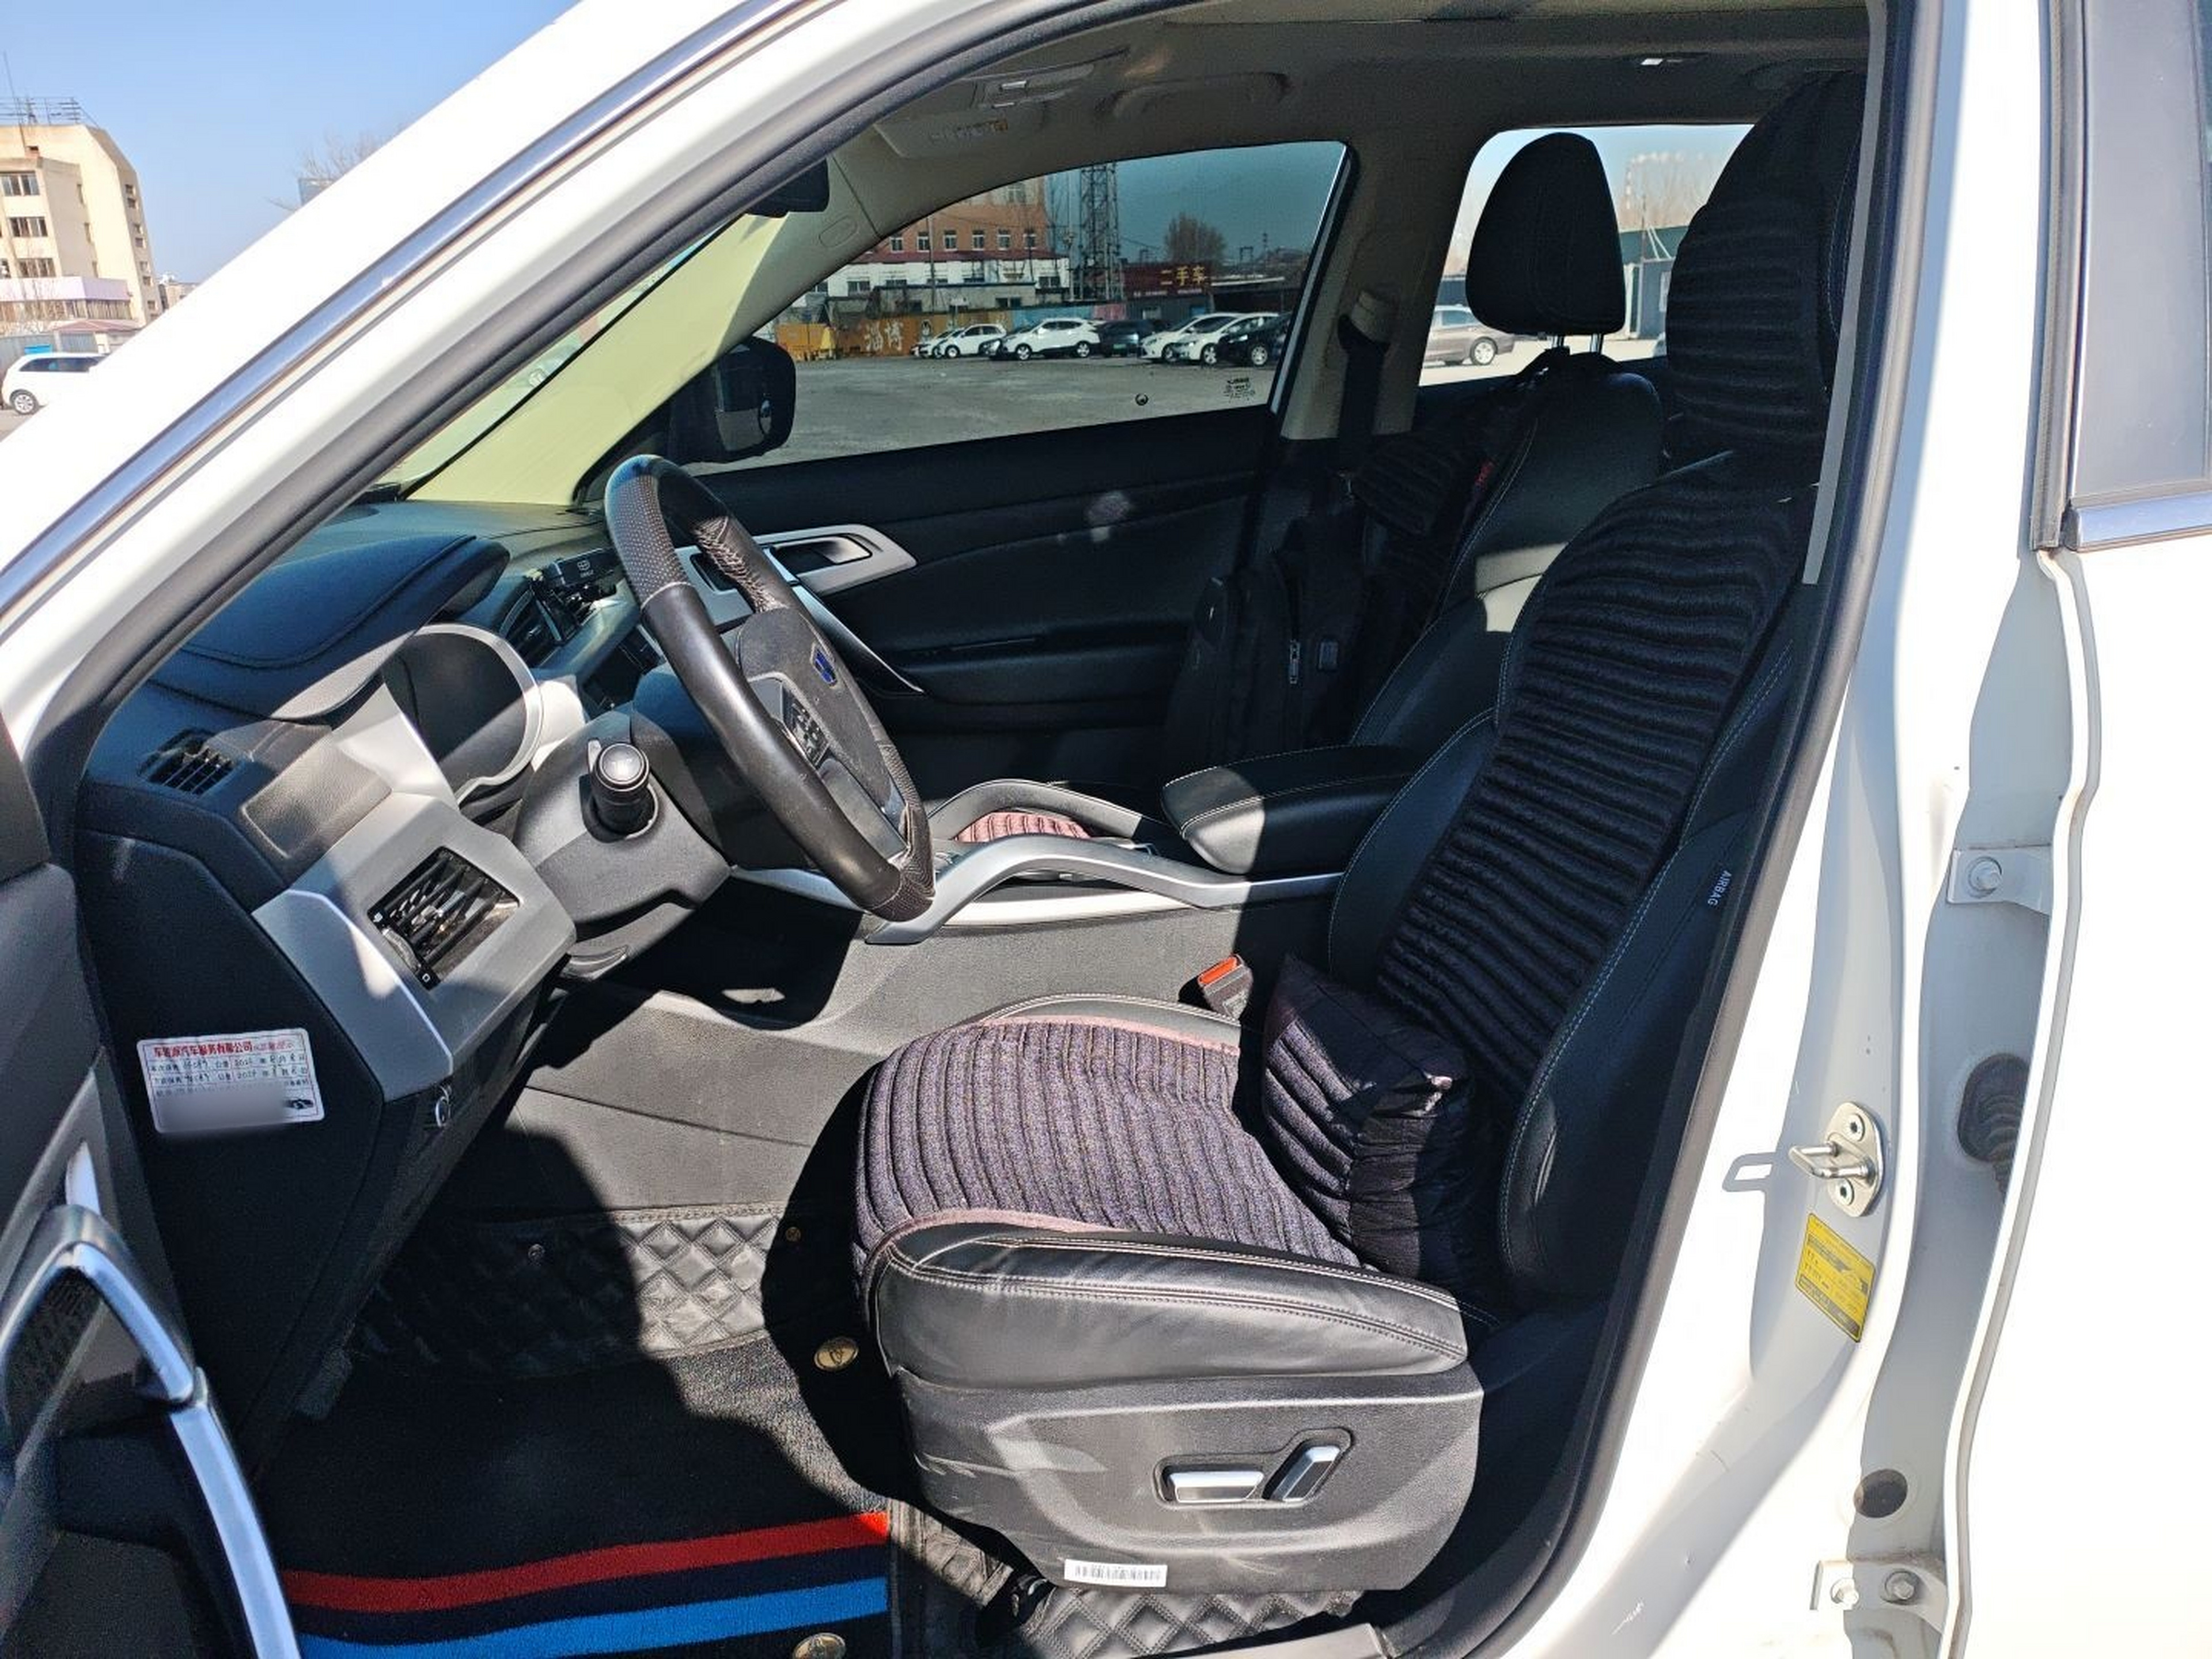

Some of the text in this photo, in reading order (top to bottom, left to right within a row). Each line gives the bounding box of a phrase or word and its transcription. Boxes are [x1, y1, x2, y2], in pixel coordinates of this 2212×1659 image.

[1161, 265, 1205, 286] 二手车
[1707, 870, 1732, 906] AIRBAG
